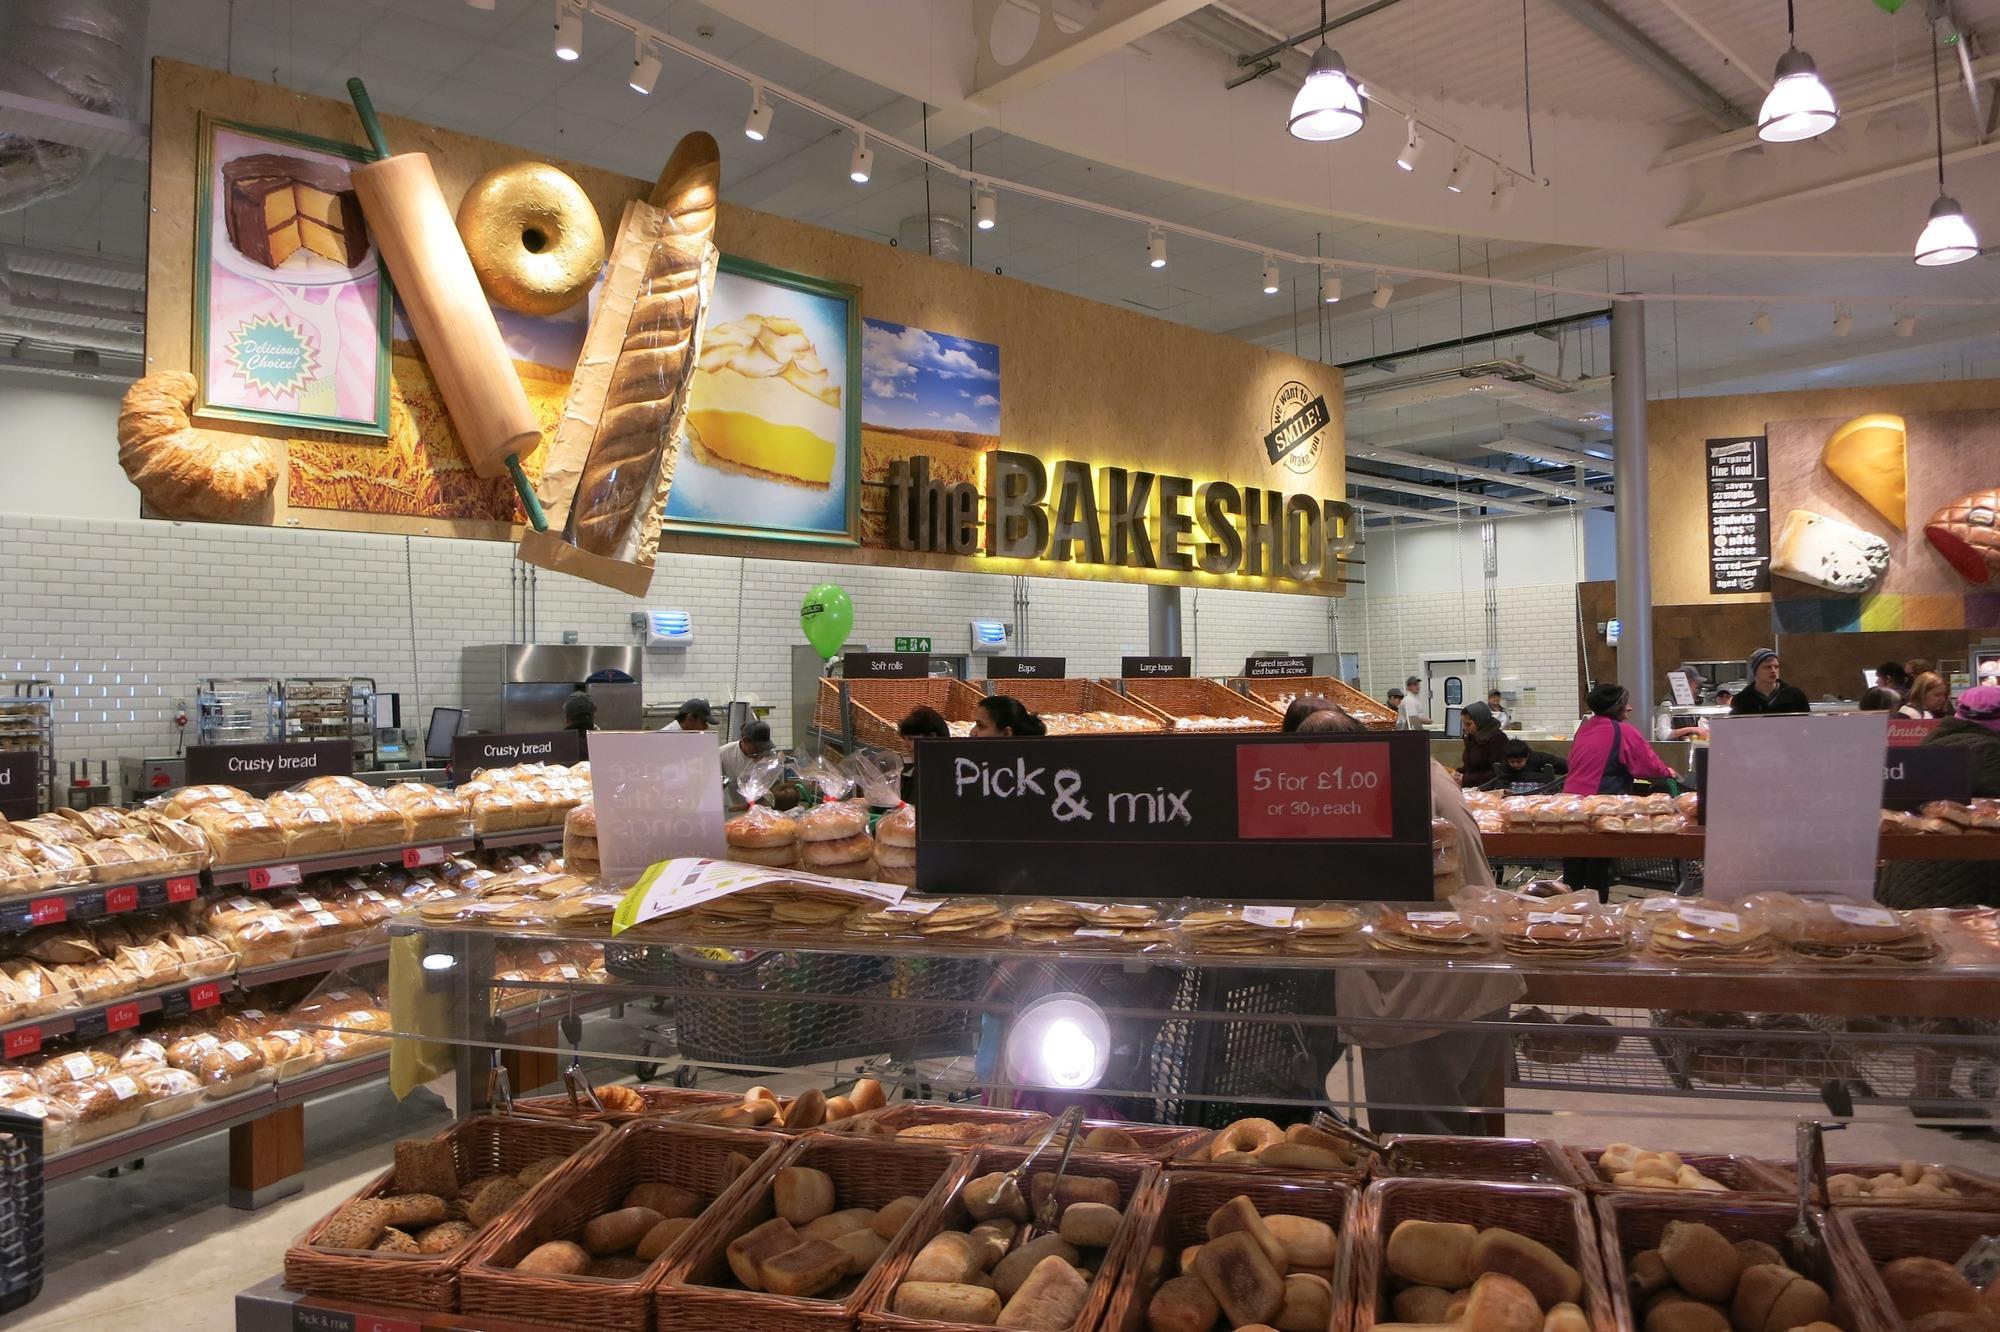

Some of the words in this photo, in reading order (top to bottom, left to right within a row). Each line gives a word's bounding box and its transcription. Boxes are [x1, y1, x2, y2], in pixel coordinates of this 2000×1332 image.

[243, 340, 300, 356] Delicious
[246, 354, 300, 370] Choice!
[1274, 405, 1282, 424] we
[1279, 386, 1299, 405] want
[1300, 388, 1309, 404] to
[1274, 404, 1322, 453] SMILE!
[1289, 453, 1311, 467] make
[1718, 454, 1752, 465] prepared
[1711, 465, 1729, 477] fine
[1730, 463, 1752, 476] food
[884, 456, 979, 556] the
[986, 450, 1356, 582] BAKESHOP
[1712, 514, 1756, 526] sandwich
[1713, 525, 1745, 535] olives
[1713, 546, 1756, 556] cheese
[1714, 561, 1741, 571] cured
[1716, 578, 1738, 589] aged
[871, 660, 887, 670] Soft
[888, 661, 904, 670] rolls
[1018, 663, 1036, 674] Baps
[1140, 663, 1157, 673] Large
[1158, 663, 1173, 673] baps
[1887, 725, 1929, 738] hnuts
[484, 744, 519, 758] Crusty
[522, 741, 552, 755] bread
[228, 757, 274, 772] Crusty
[278, 753, 317, 769] bread
[1253, 768, 1273, 791] 5
[1278, 772, 1309, 791] for
[1317, 766, 1378, 790] £1.00
[954, 757, 1046, 798] Pick
[1051, 769, 1094, 822] &
[1108, 787, 1193, 825] mix
[1267, 804, 1285, 816] or
[1290, 801, 1320, 817] 30p
[1322, 800, 1361, 815] each
